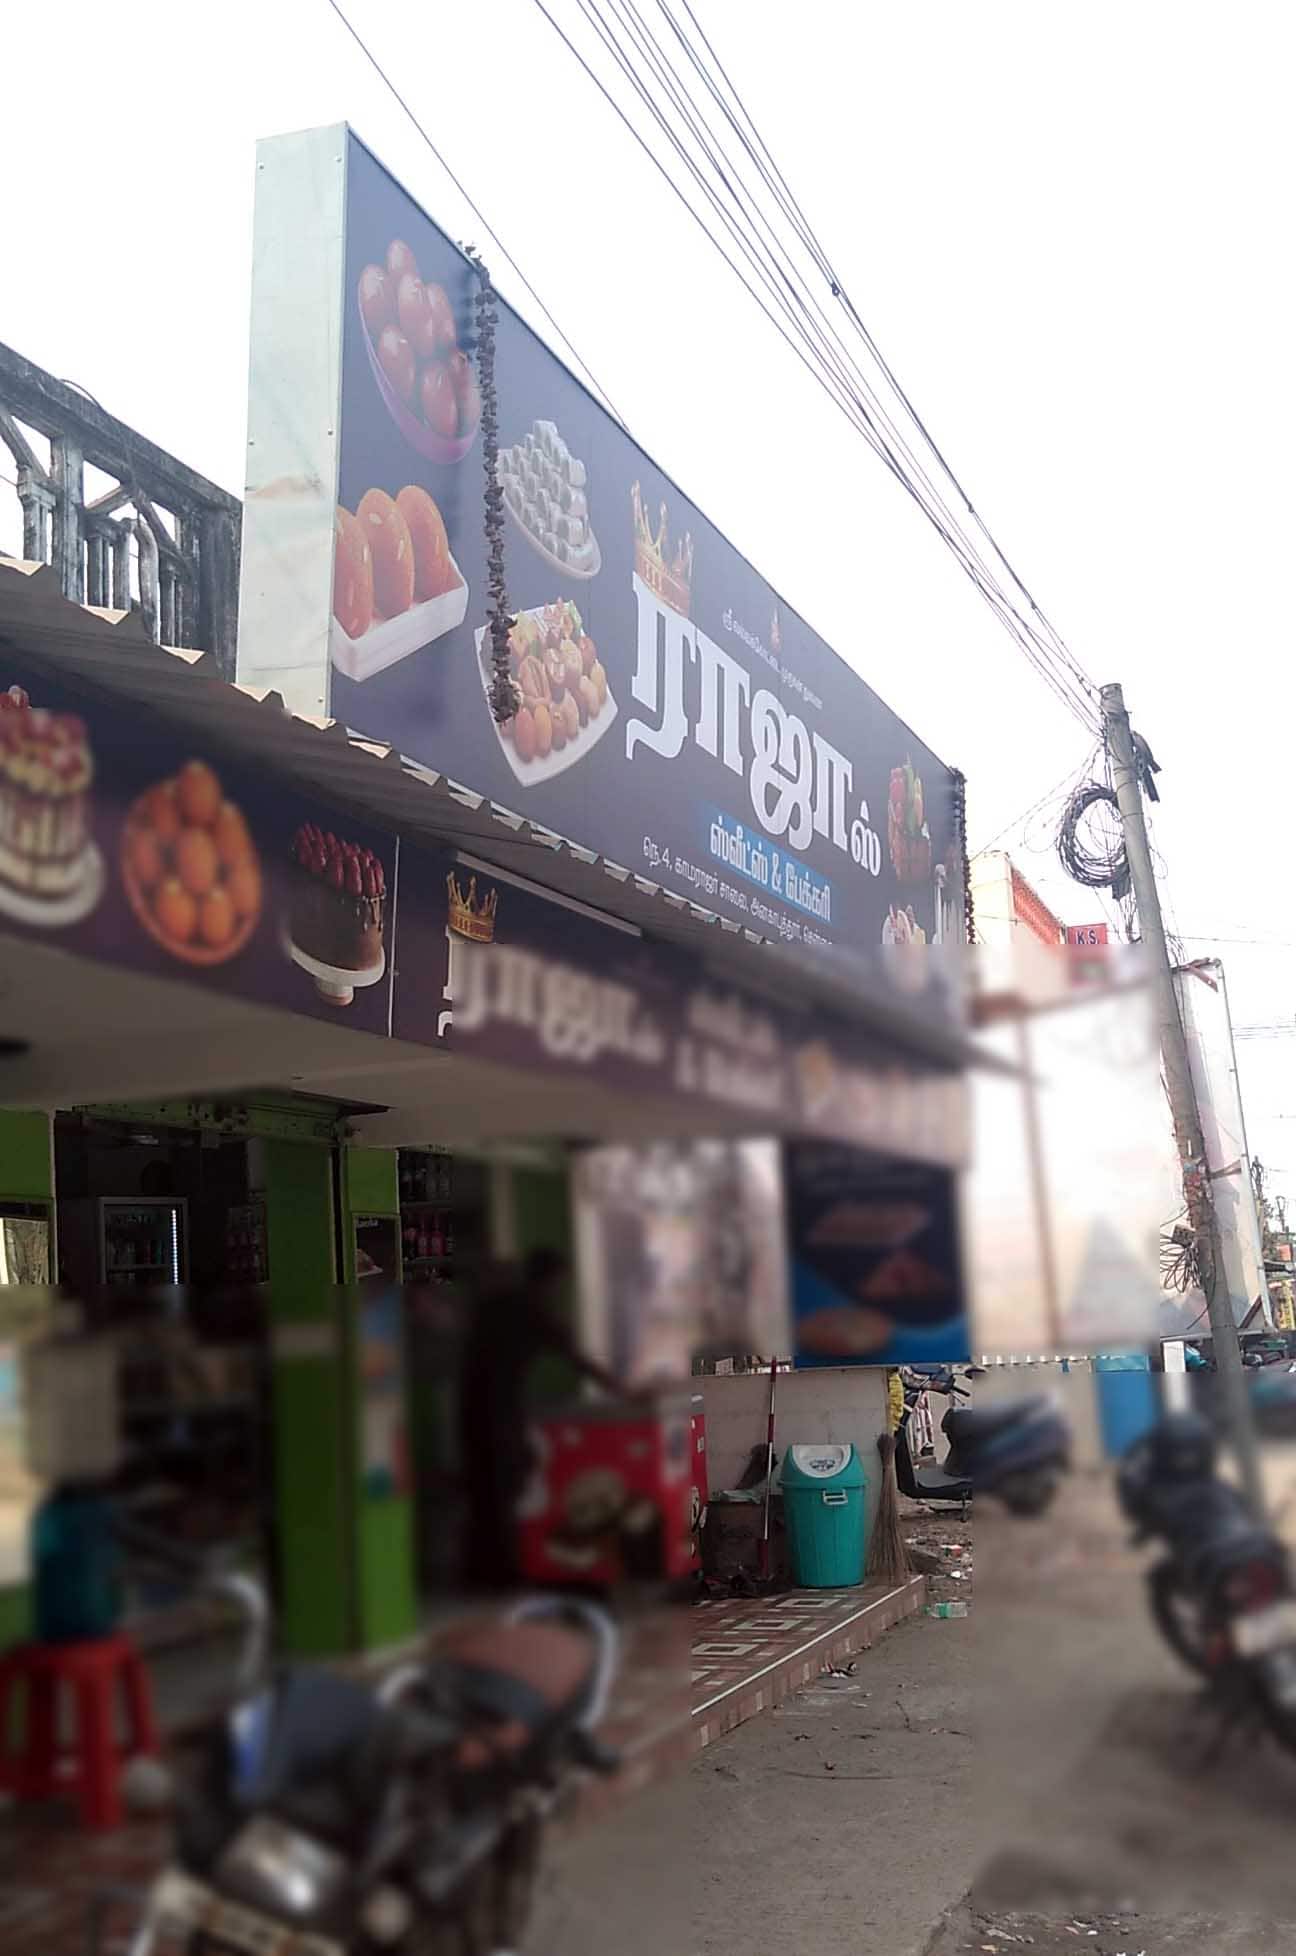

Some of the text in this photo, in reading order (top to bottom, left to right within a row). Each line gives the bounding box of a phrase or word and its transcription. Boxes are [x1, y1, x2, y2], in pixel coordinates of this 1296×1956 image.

[626, 571, 882, 877] ராஜாஸ்
[674, 857, 719, 896] காமராஜர்
[710, 815, 831, 923] ஸ்வீட்ஸ் & பேக்கரி
